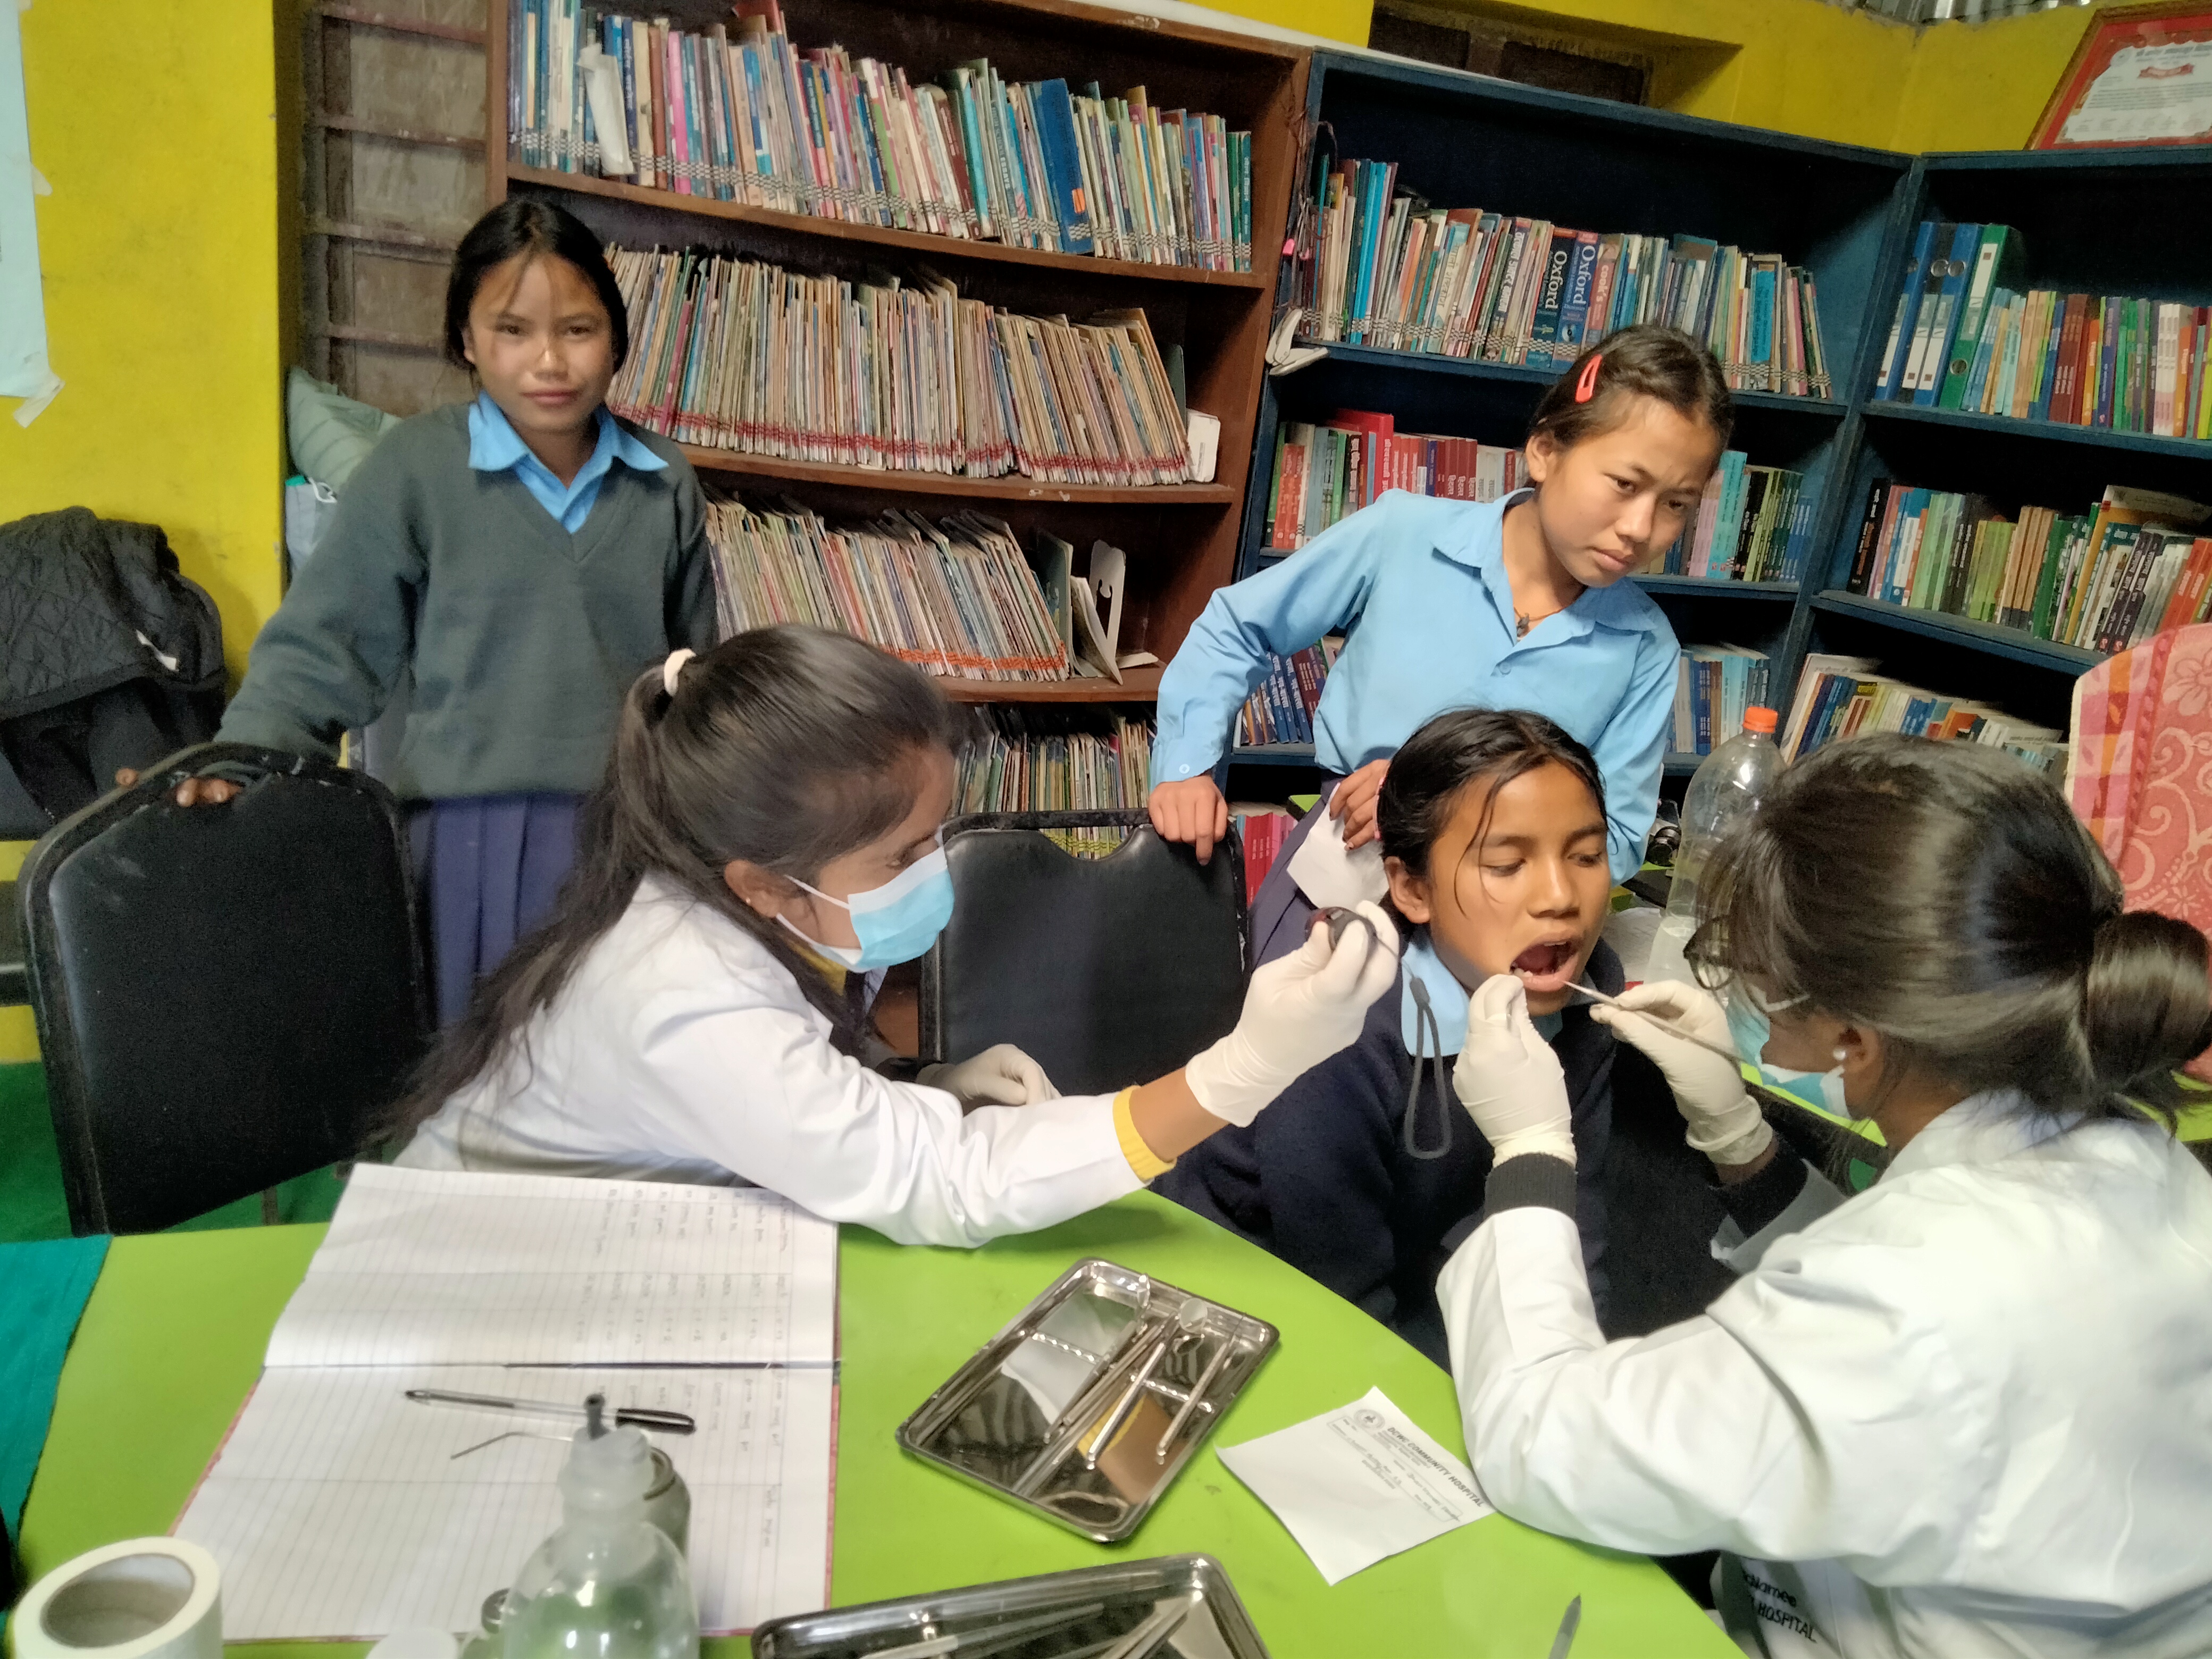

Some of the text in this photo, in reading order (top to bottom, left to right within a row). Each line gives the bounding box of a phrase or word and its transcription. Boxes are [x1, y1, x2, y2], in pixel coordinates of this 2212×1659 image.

[999, 156, 1010, 189] ESSAYS
[1547, 250, 1568, 309] Oxford
[1574, 245, 1596, 305] Oxford
[1597, 265, 1610, 303] cook's
[1386, 1425, 1484, 1507] DCWC COMMUNITY HOSPITAL
[1758, 1602, 1817, 1644] HOSPITAL
